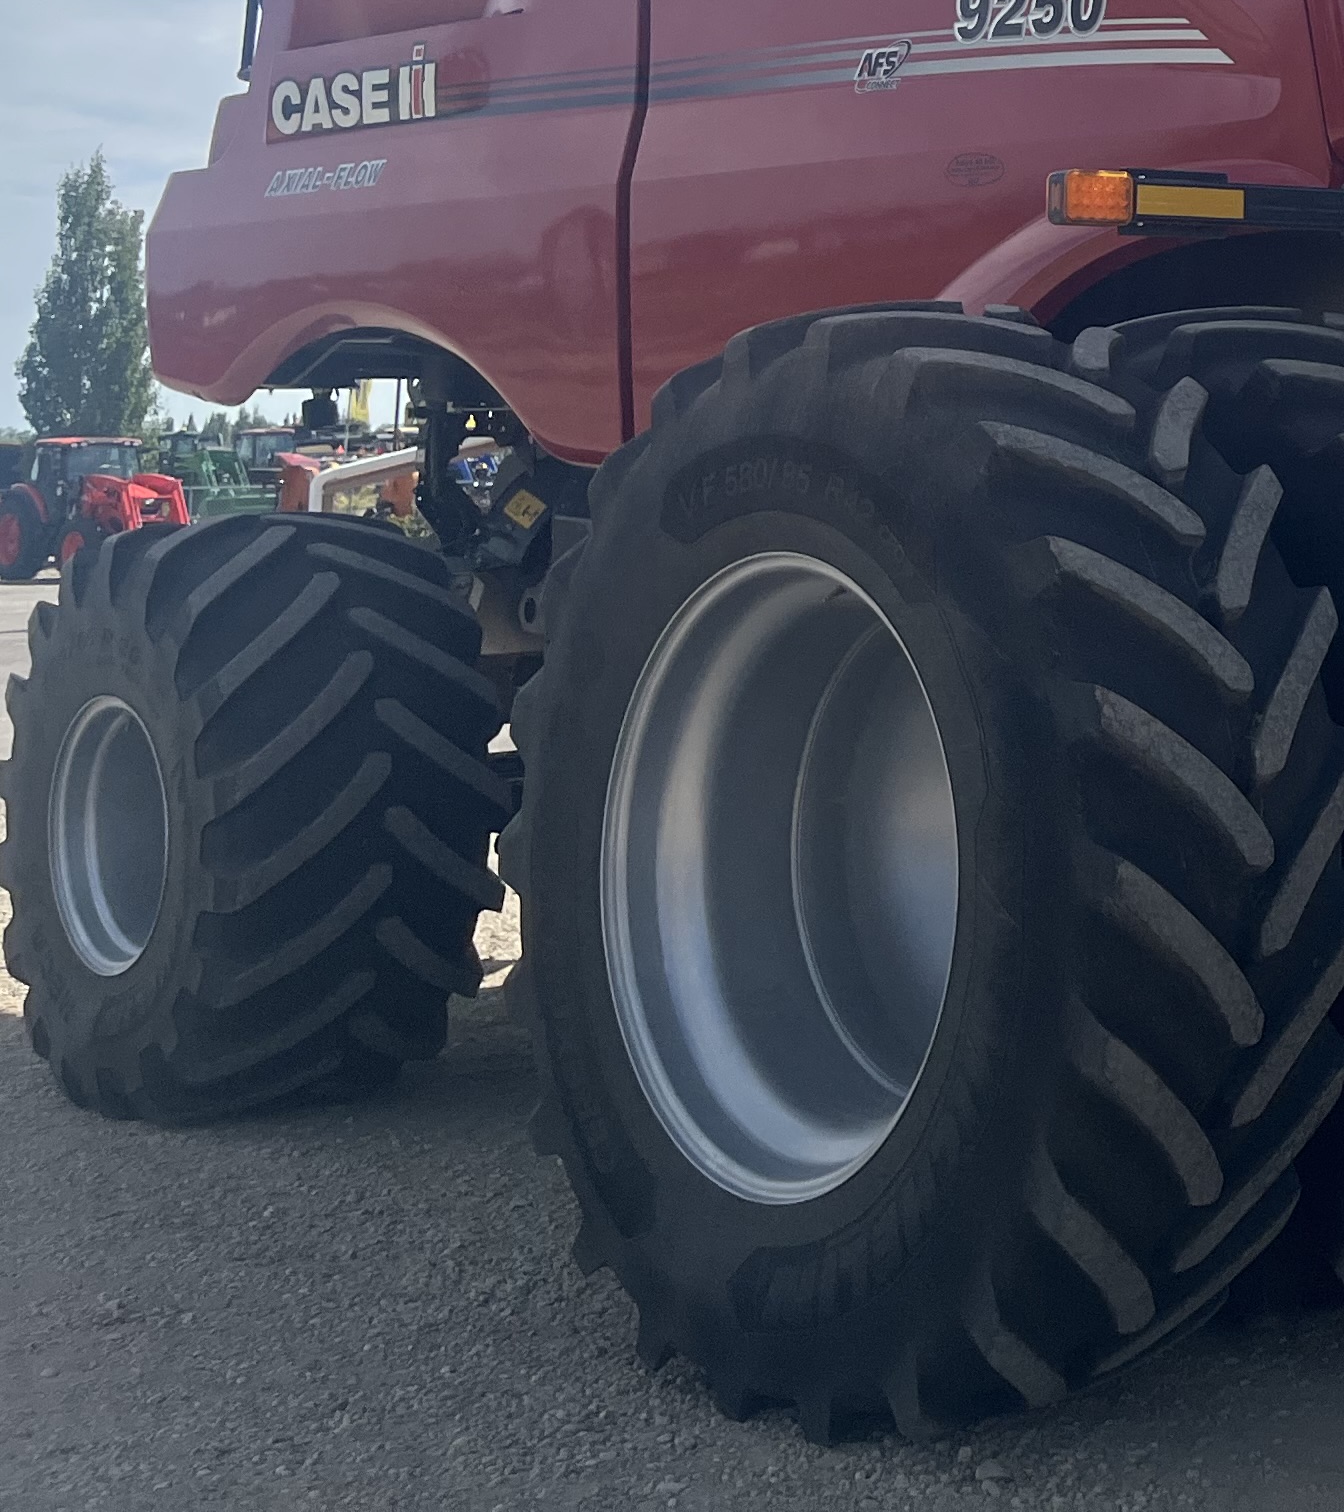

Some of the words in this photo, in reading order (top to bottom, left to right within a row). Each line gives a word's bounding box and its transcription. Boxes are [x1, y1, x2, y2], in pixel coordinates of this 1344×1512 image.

[854, 46, 901, 80] AFS
[271, 68, 390, 135] CASE
[264, 159, 388, 198] AXIAL-FLOW
